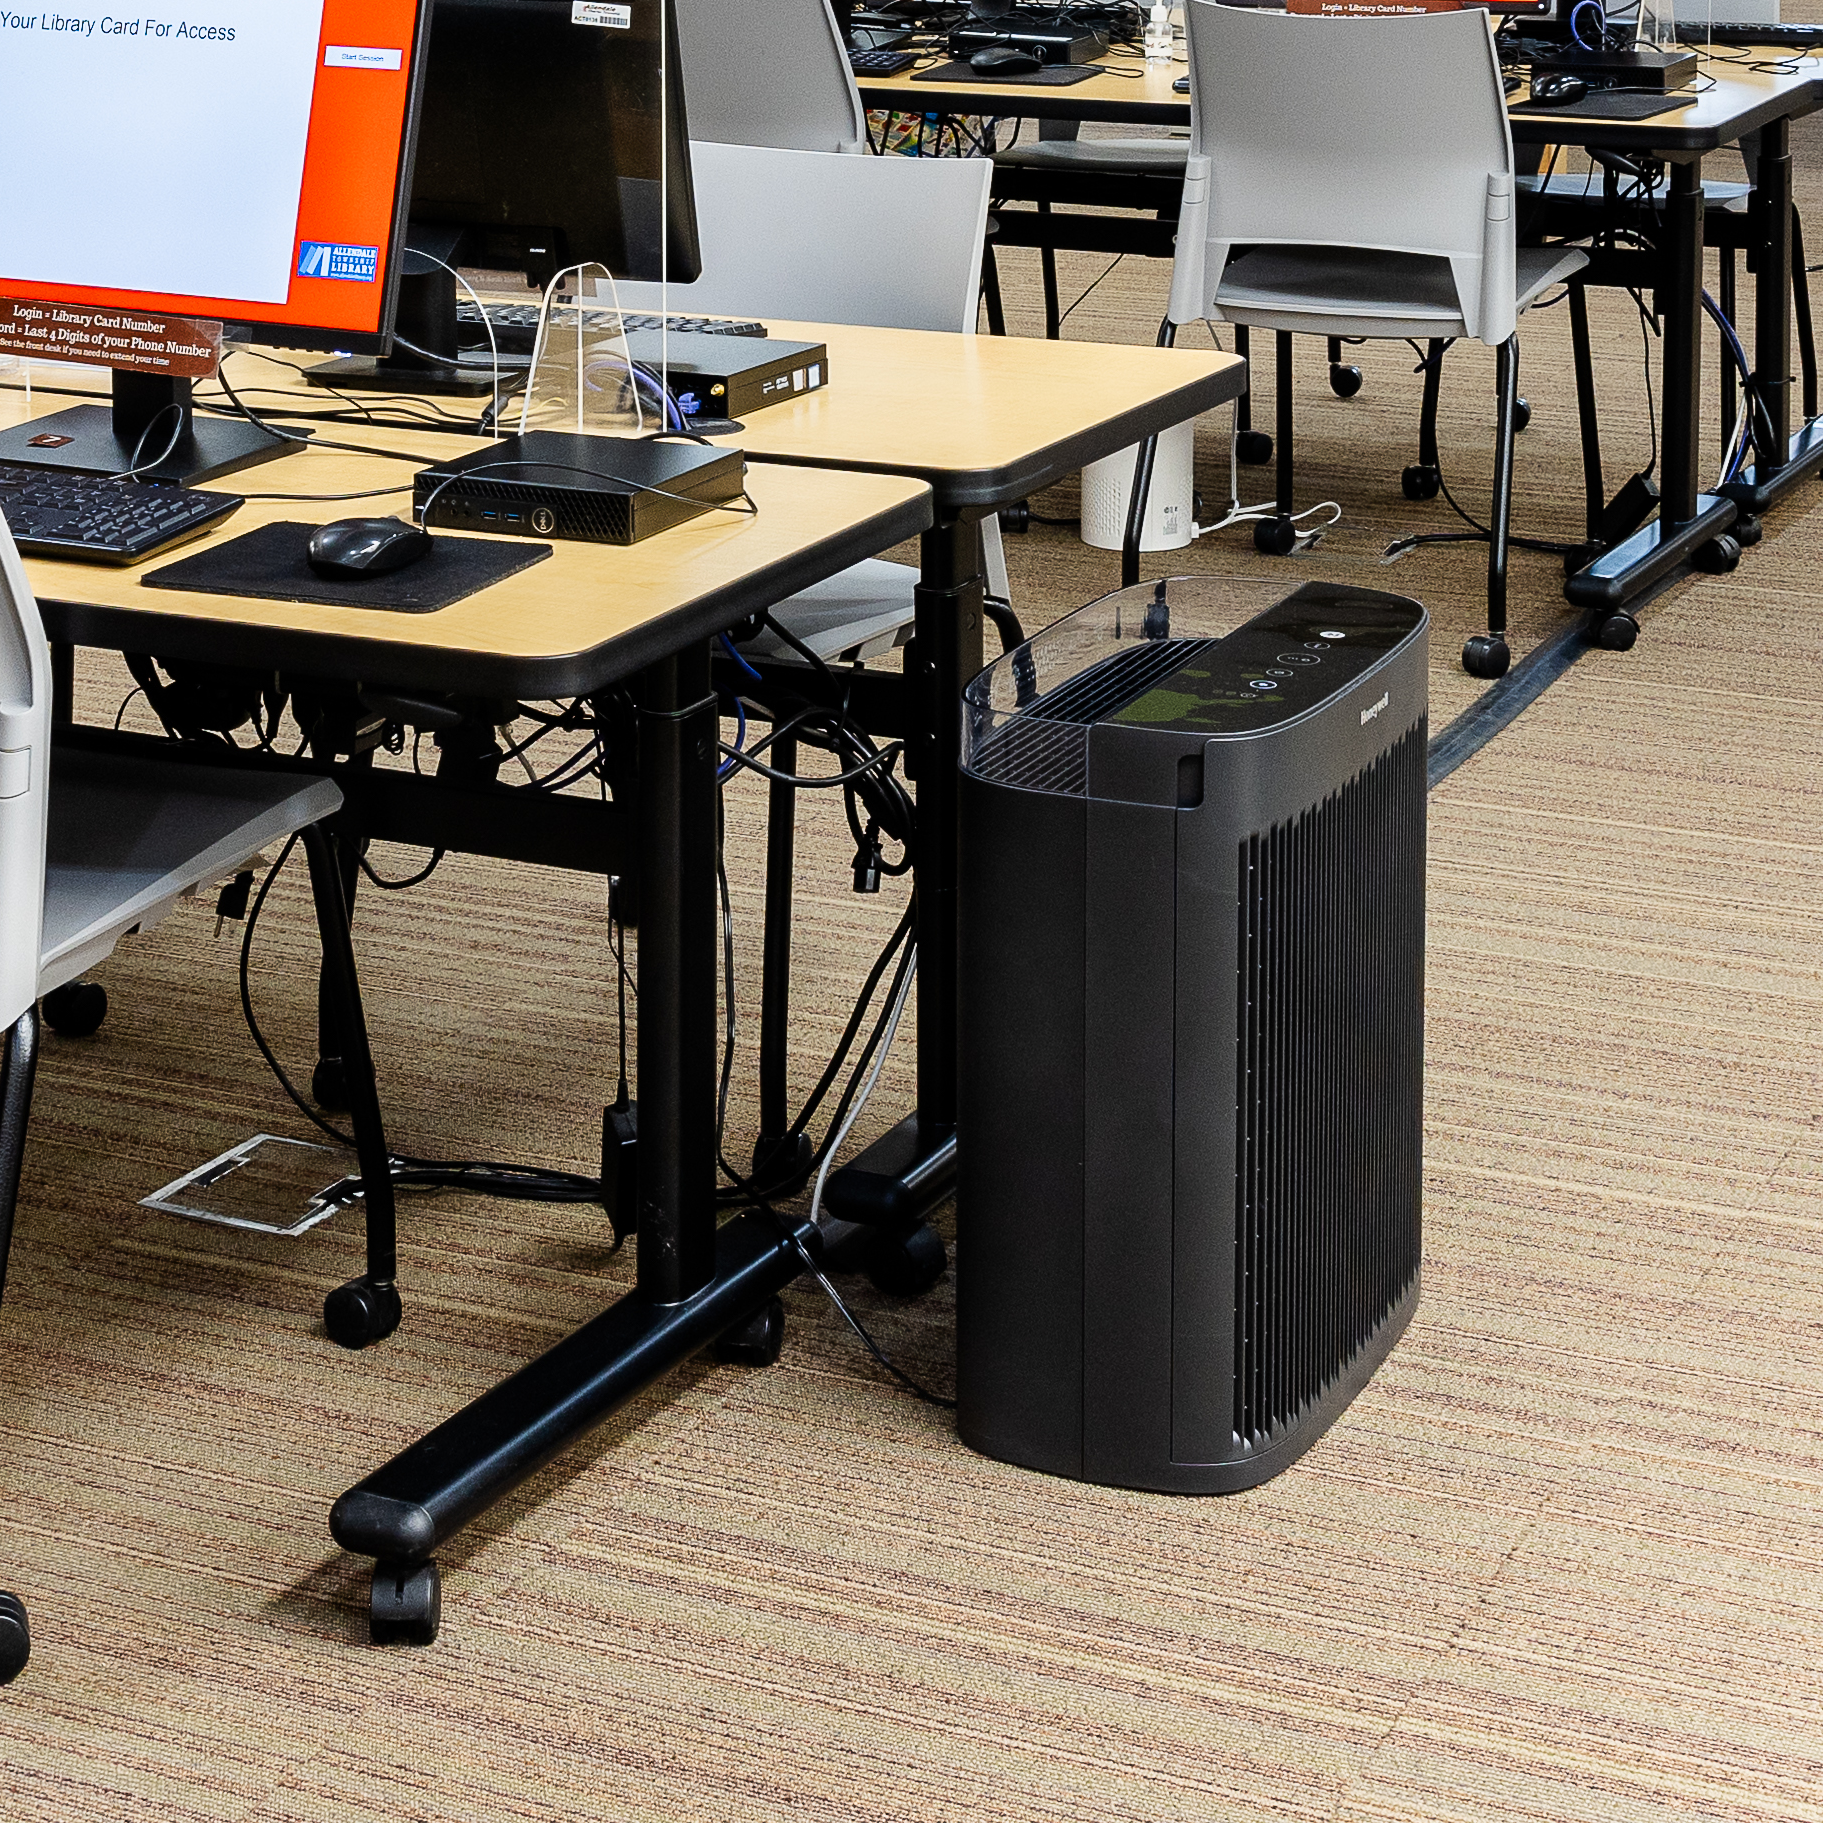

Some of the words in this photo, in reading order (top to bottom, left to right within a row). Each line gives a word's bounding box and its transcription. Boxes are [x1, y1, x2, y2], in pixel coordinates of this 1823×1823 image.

[0, 11, 38, 31] Your
[42, 13, 96, 36] Library
[100, 17, 139, 36] Card
[145, 19, 172, 38] For
[176, 21, 236, 42] Access
[333, 247, 377, 257] ALLENDALE
[333, 256, 375, 265] TOWNSHIP
[331, 263, 375, 274] LIBRARY
[13, 305, 43, 320] Login
[52, 309, 92, 327] Library
[94, 314, 120, 329] Card
[122, 317, 165, 334] Number
[0, 337, 12, 346] See
[12, 340, 24, 348] the
[26, 340, 44, 350] front
[45, 343, 61, 353] desk
[62, 344, 69, 354] if
[69, 347, 83, 357] you
[83, 348, 101, 358] need
[102, 350, 109, 359] to
[110, 351, 135, 362] extend
[135, 354, 152, 365] your
[153, 356, 169, 366] time
[24, 325, 48, 338] Last
[50, 330, 56, 342] 4
[58, 327, 90, 344] Digits
[92, 331, 105, 345] of
[104, 335, 129, 349] your
[130, 337, 164, 352] Phone
[166, 341, 212, 358] Number
[1360, 693, 1390, 726] Honeywell
